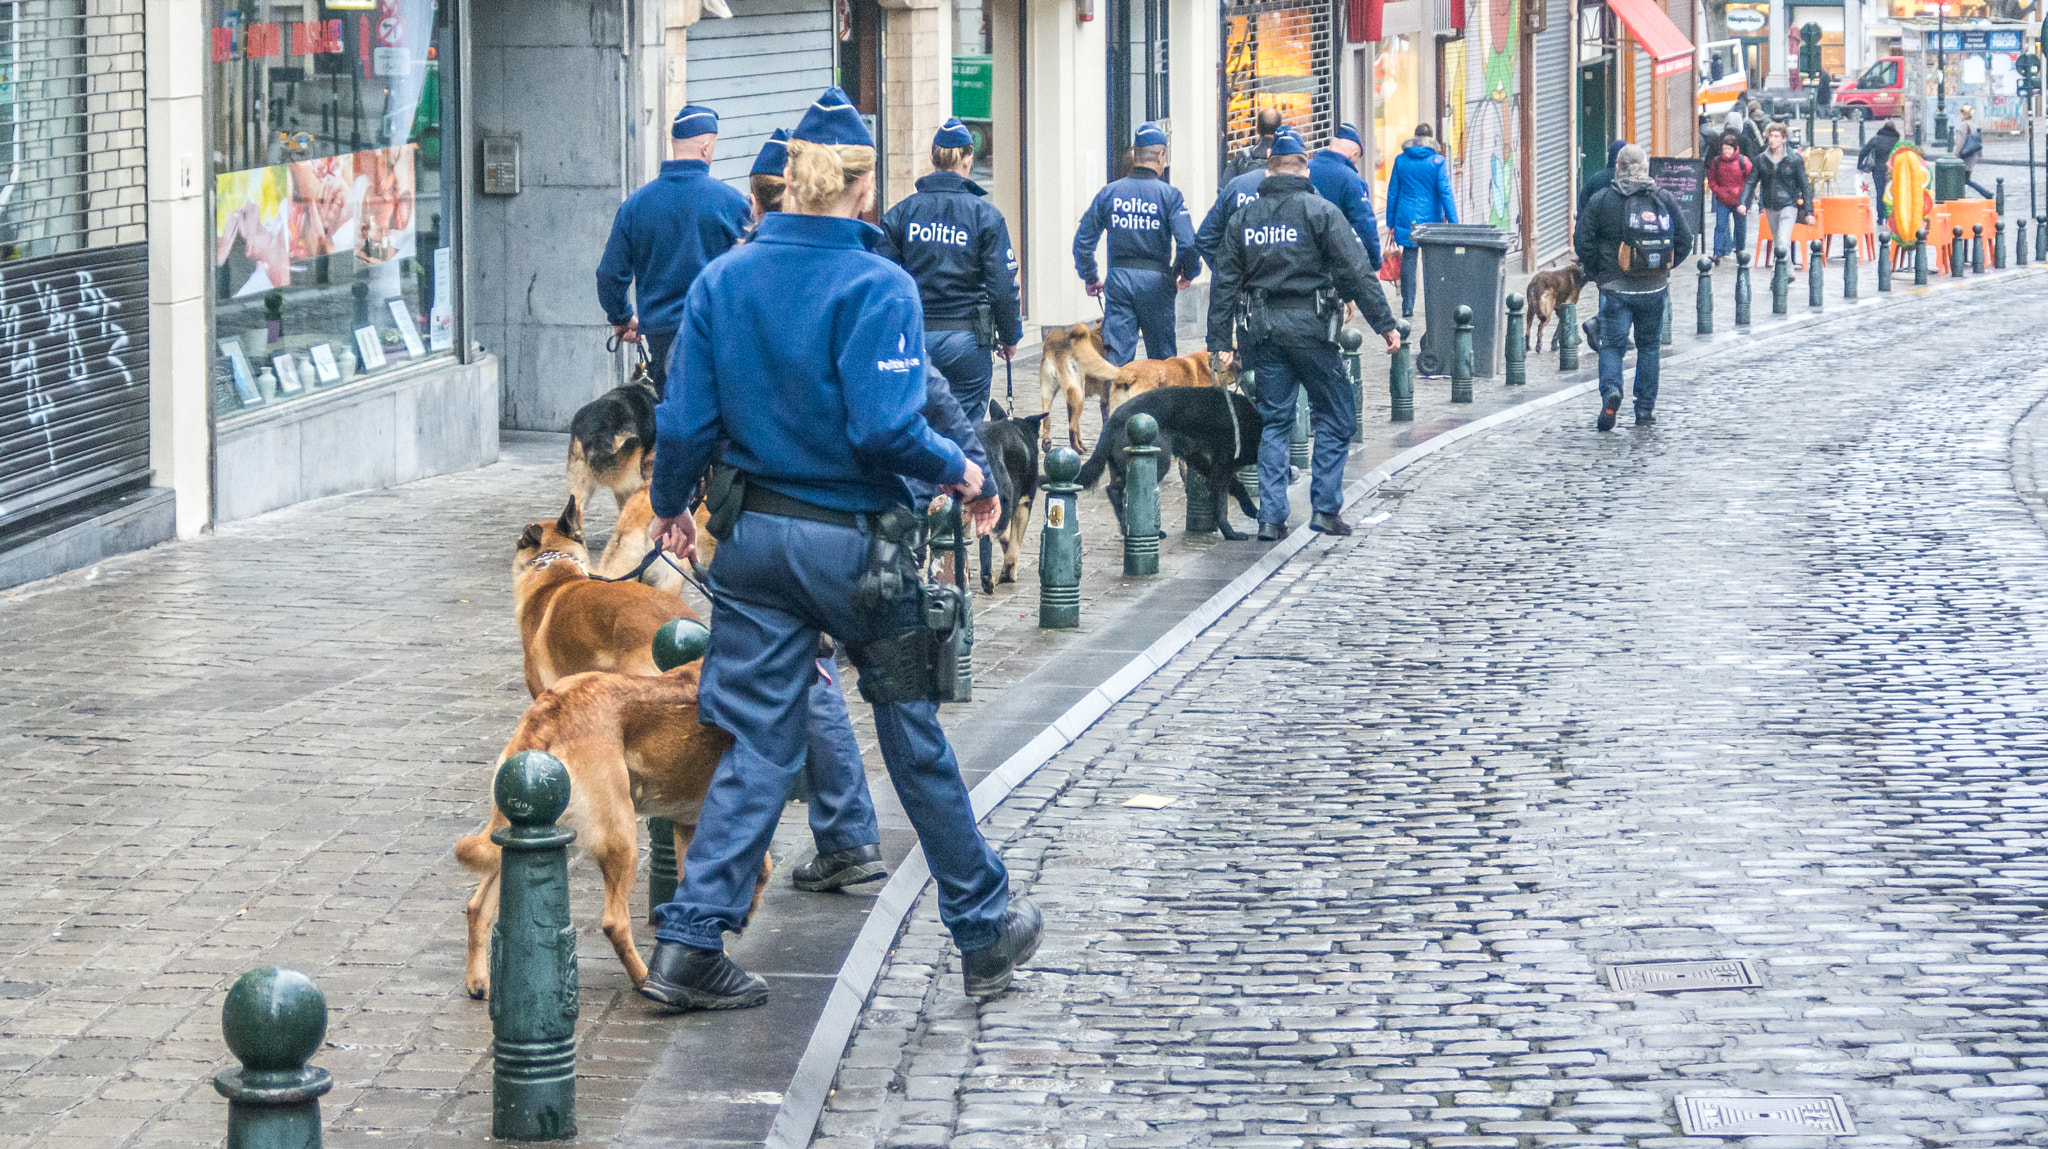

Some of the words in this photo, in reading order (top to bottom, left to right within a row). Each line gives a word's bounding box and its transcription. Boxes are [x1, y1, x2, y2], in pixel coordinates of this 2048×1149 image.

[1113, 198, 1158, 214] Police
[1111, 214, 1160, 230] Politie
[908, 222, 968, 246] Politie
[1244, 224, 1298, 246] Politie
